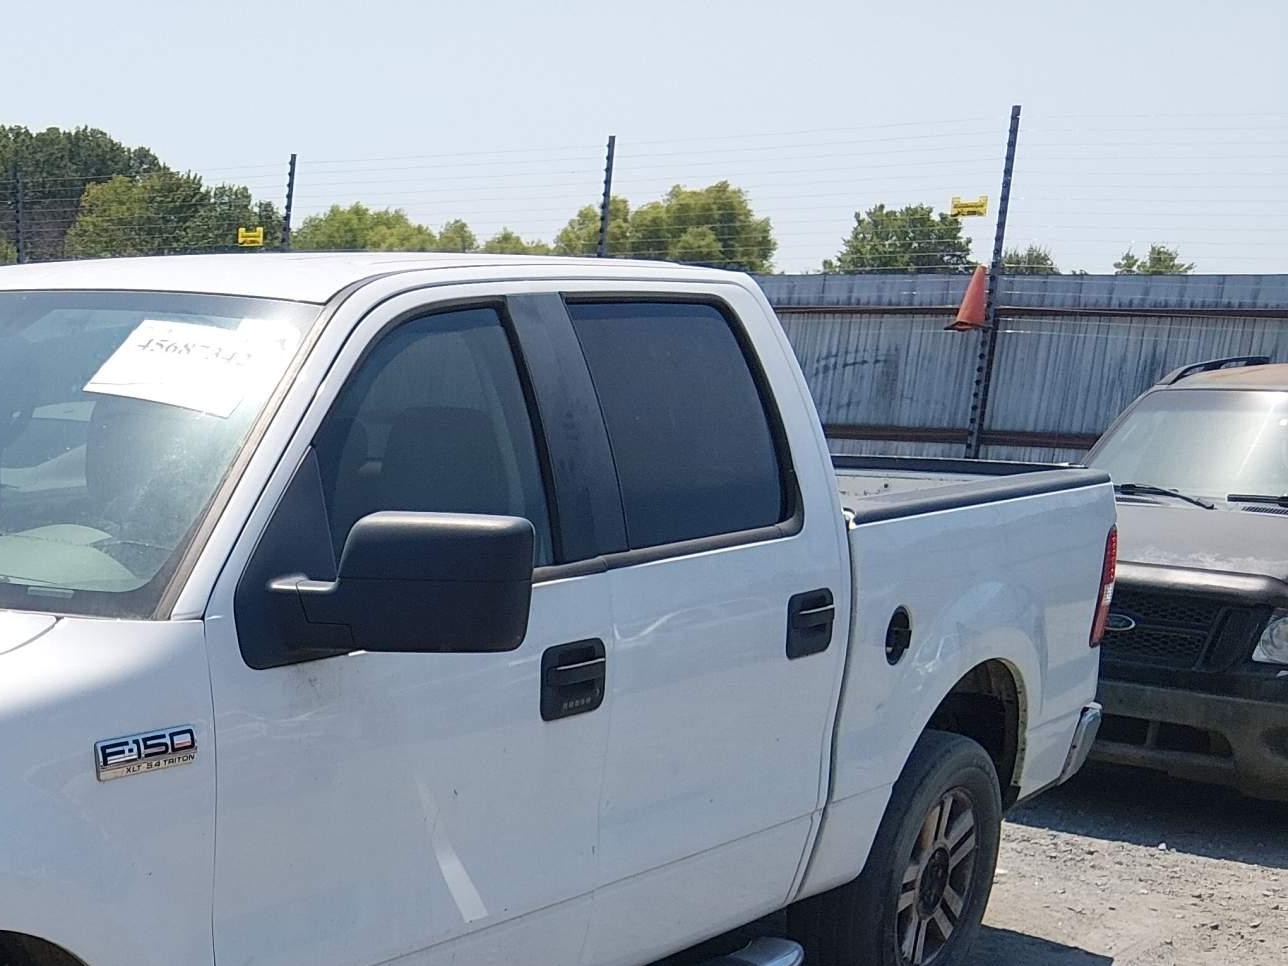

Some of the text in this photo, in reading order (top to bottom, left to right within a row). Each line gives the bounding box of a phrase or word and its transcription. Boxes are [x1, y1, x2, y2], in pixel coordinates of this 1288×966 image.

[100, 728, 196, 767] F-150
[125, 764, 142, 775] XLT
[163, 753, 196, 767] TRITON
